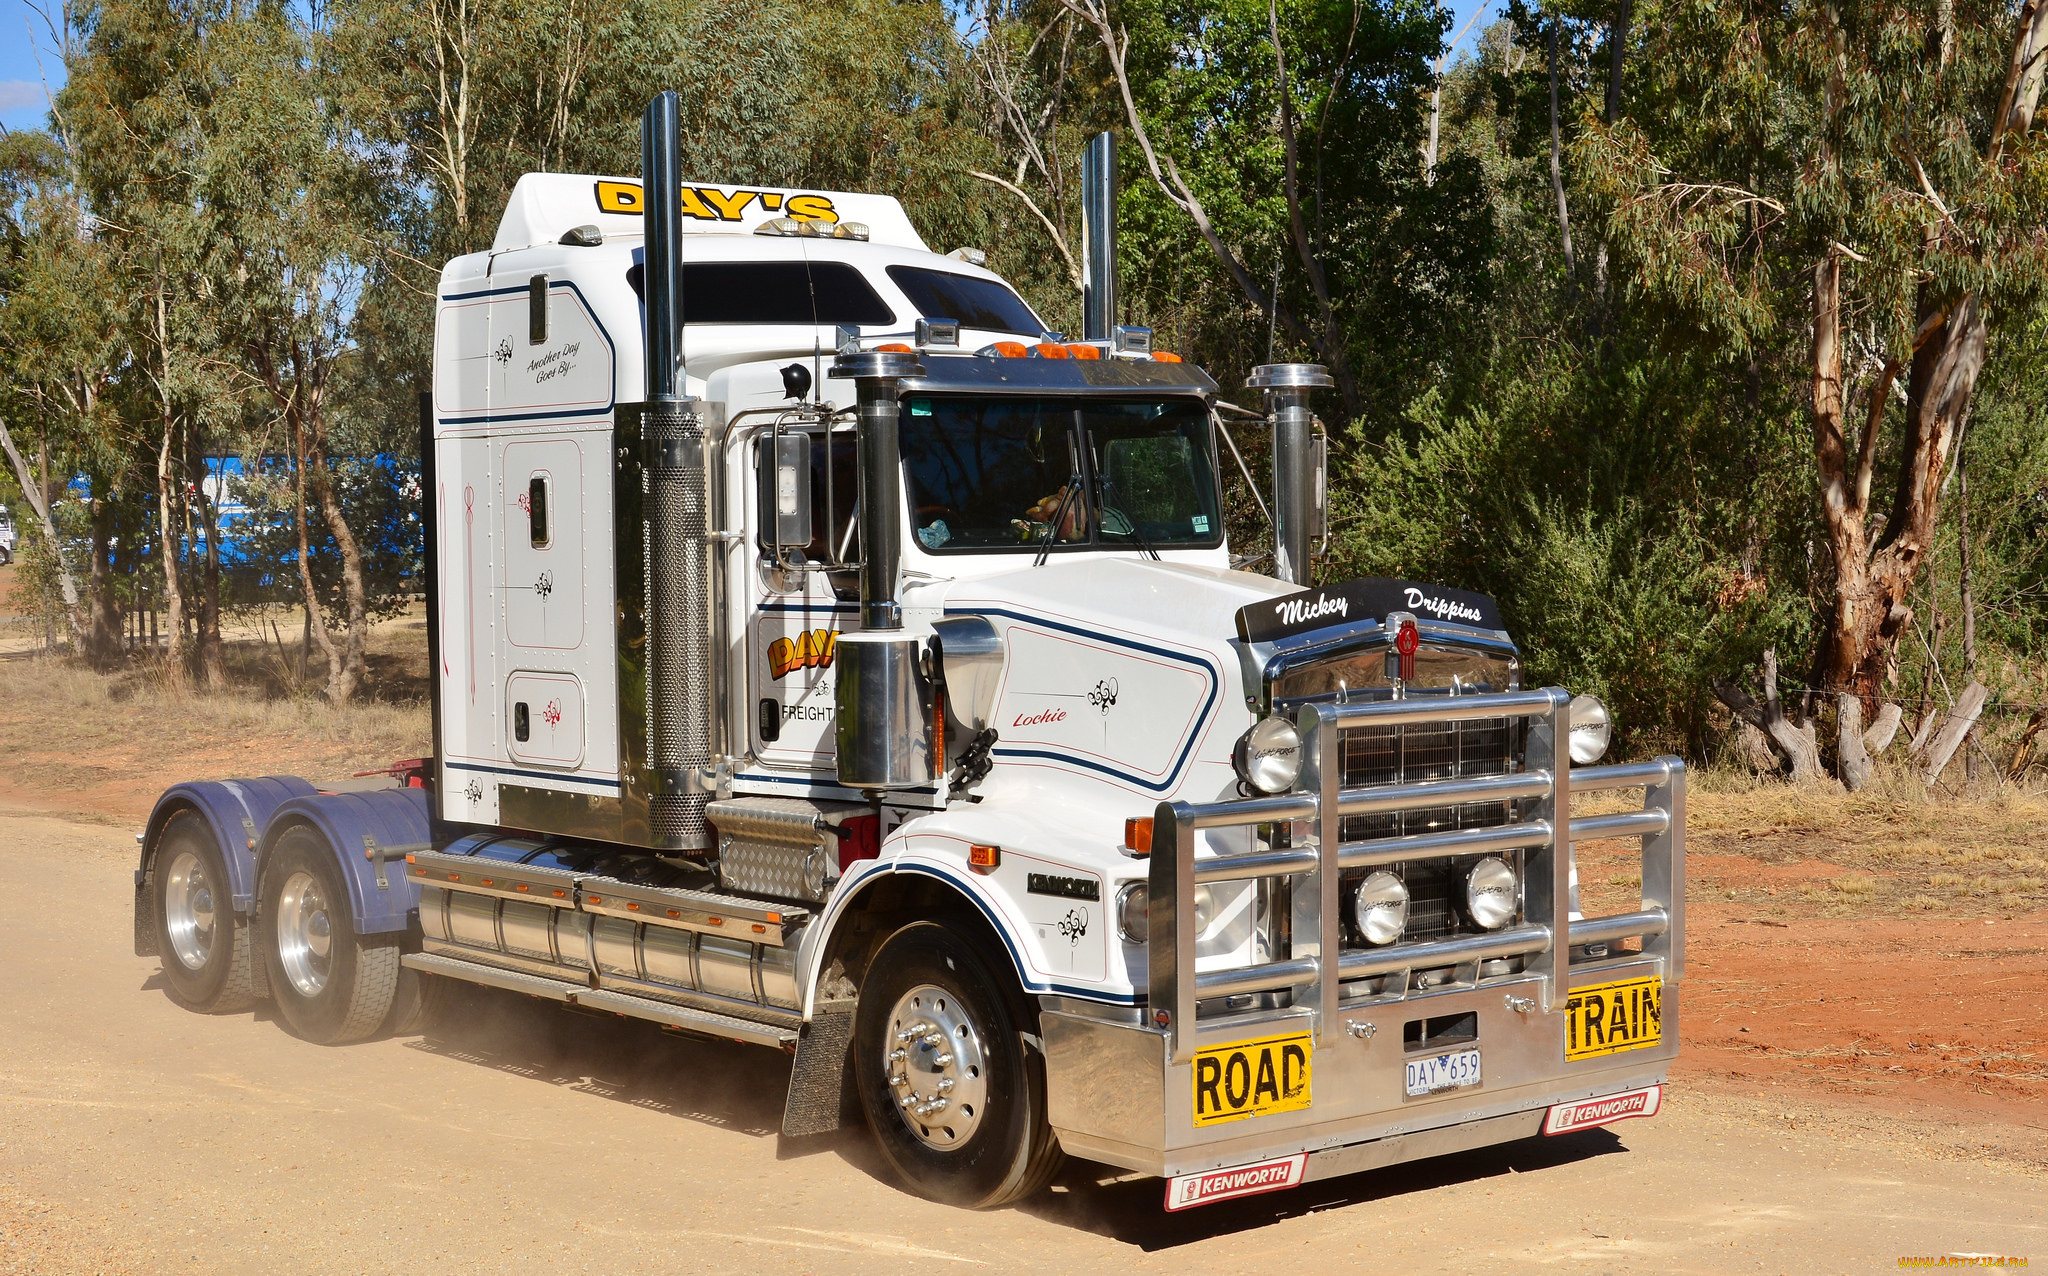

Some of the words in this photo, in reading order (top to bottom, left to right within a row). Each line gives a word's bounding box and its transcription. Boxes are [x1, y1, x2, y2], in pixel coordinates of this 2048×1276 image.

[594, 180, 840, 225] DAY'S
[527, 350, 560, 373] Another
[562, 341, 581, 357] Day
[535, 368, 556, 384] Goes
[1275, 593, 1348, 626] Mickey
[1403, 587, 1482, 622] Drippins
[781, 705, 837, 721] FREIGHT
[1013, 708, 1067, 727] Lochie
[1565, 986, 1661, 1050] TRAIN
[1197, 1044, 1306, 1115] ROAD
[1408, 1060, 1437, 1088] DAY
[1450, 1053, 1478, 1080] 659
[1575, 1095, 1645, 1122] KENWORTH
[1201, 1164, 1289, 1195] KENWORTH
